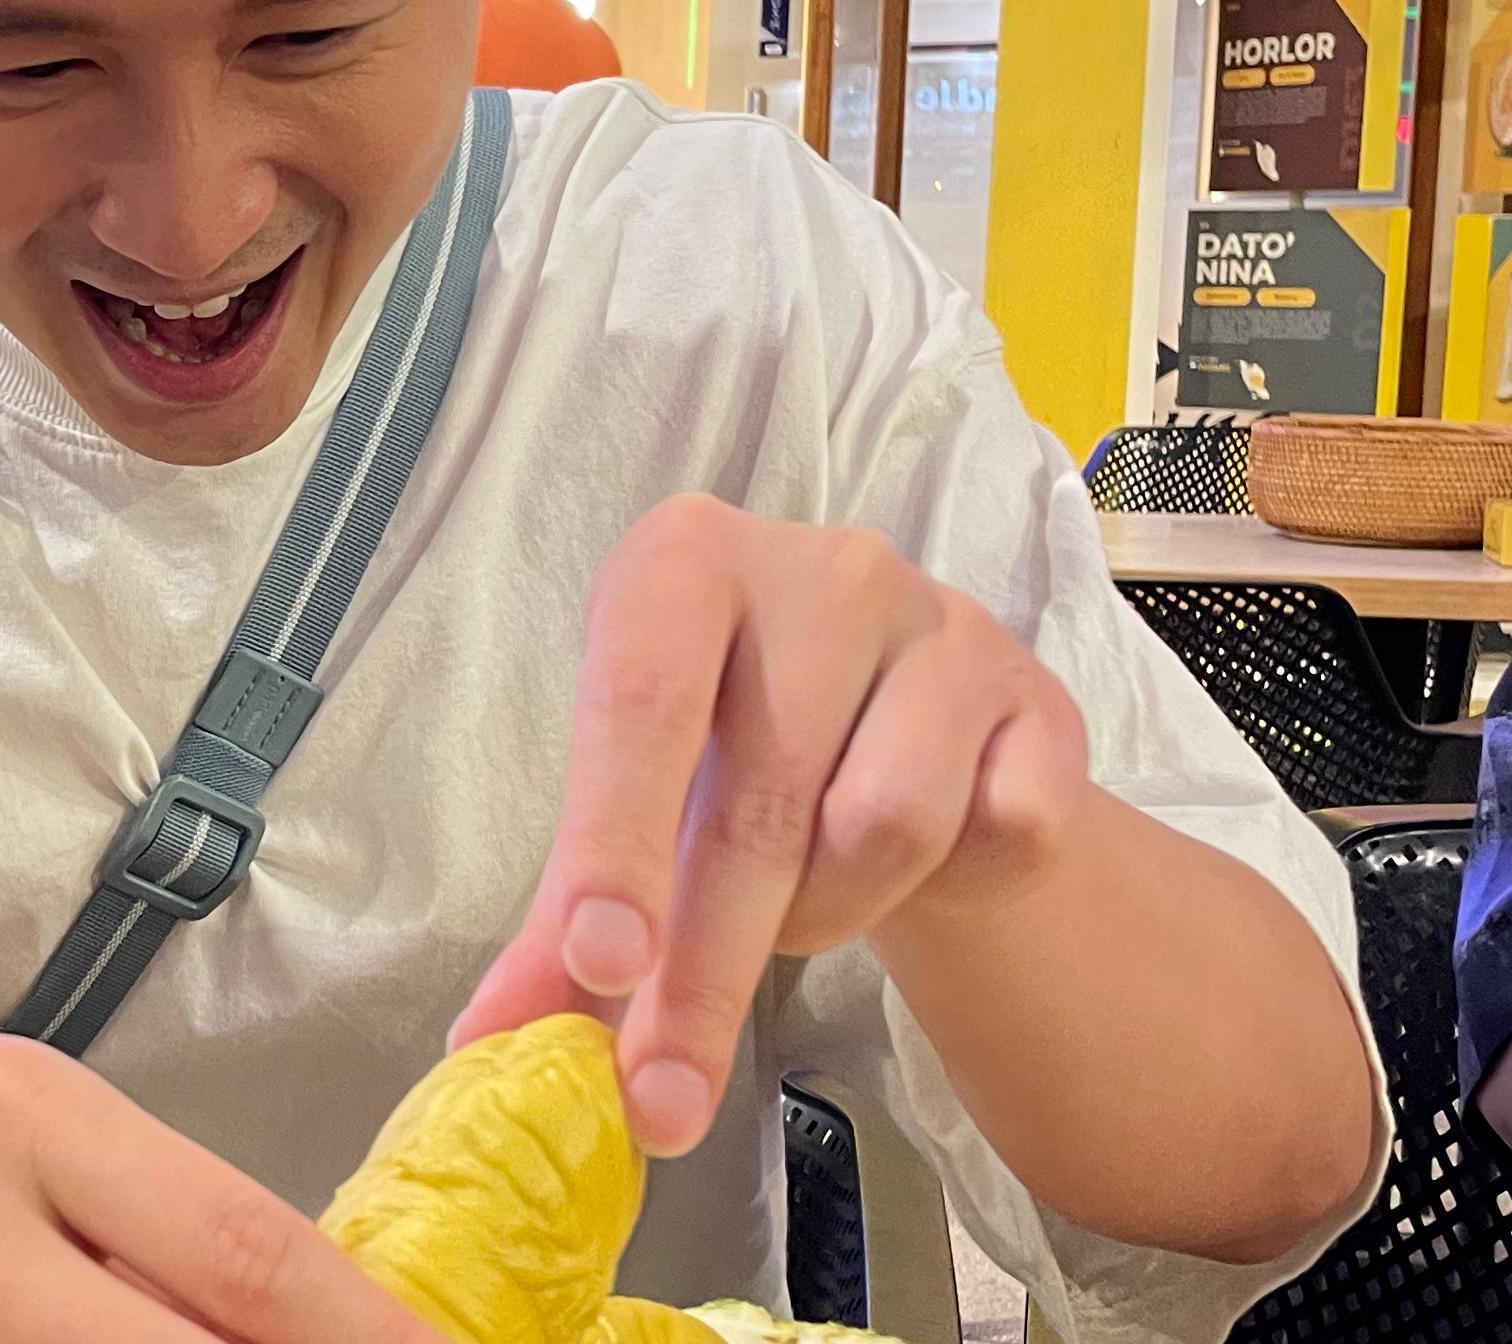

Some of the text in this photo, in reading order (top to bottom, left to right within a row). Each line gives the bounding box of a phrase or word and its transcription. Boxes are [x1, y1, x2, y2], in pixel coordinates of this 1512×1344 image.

[1224, 32, 1336, 67] HORLOR
[1197, 231, 1295, 259] DATO'
[1196, 259, 1276, 285] NINA
